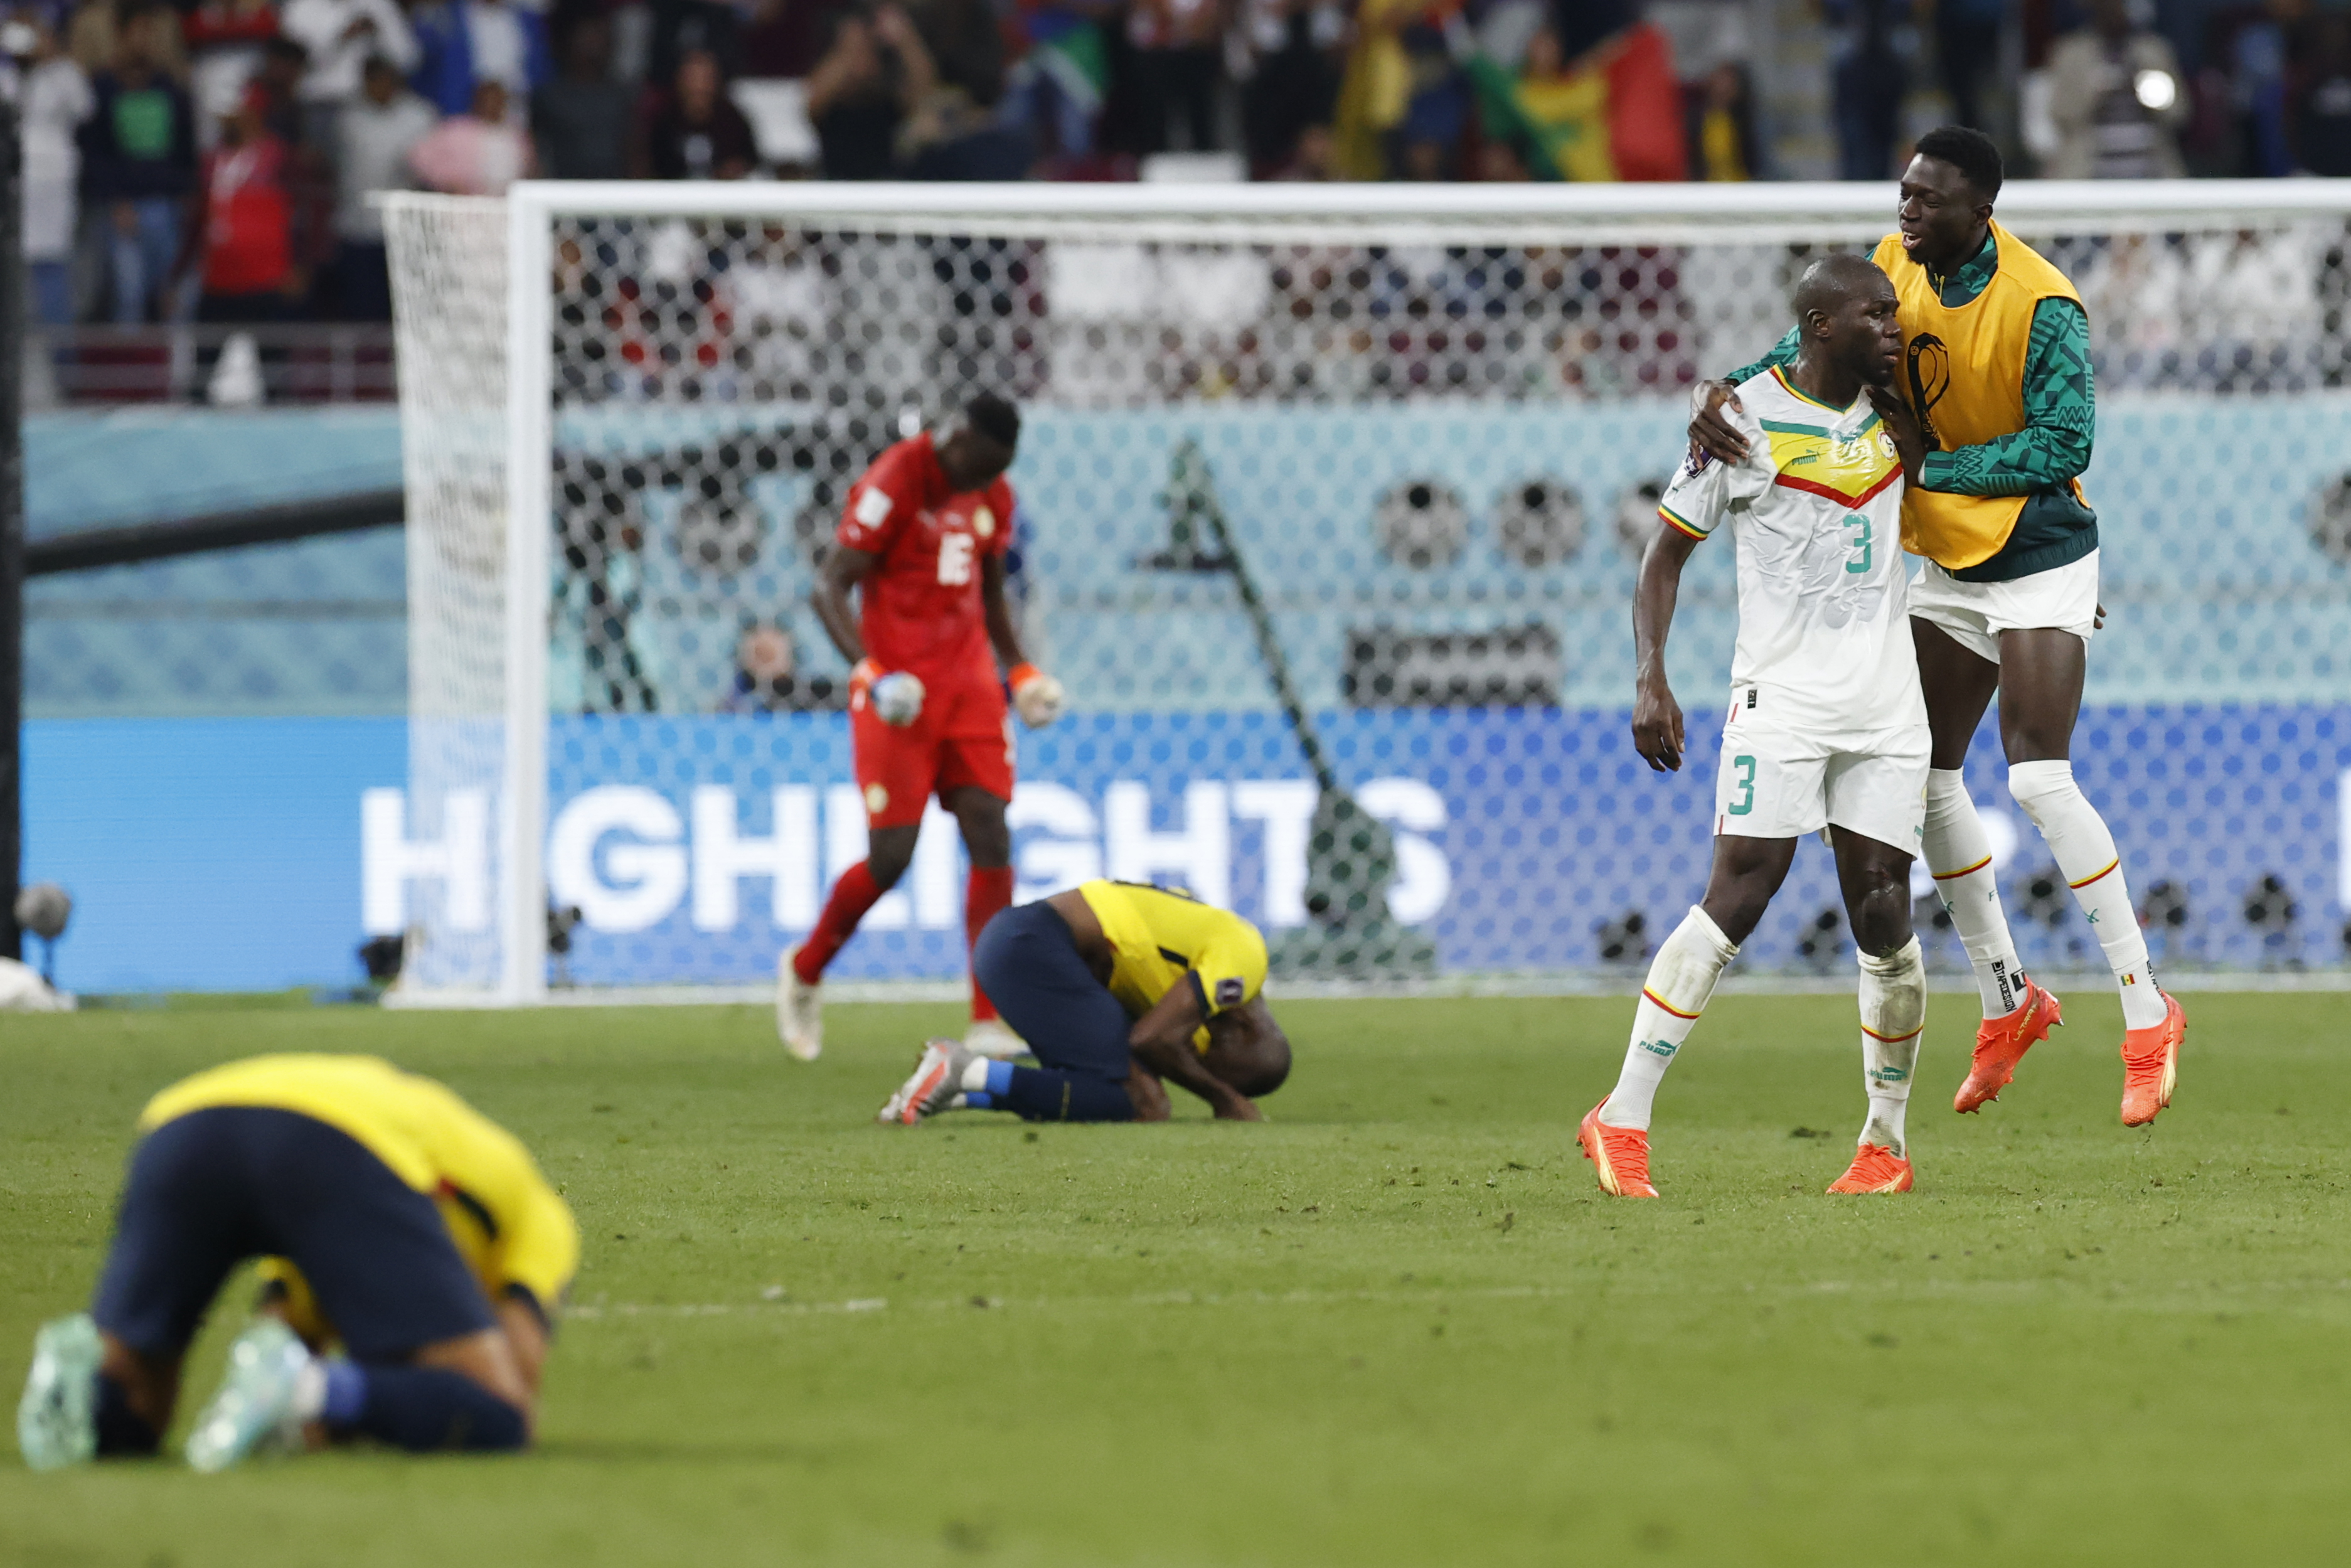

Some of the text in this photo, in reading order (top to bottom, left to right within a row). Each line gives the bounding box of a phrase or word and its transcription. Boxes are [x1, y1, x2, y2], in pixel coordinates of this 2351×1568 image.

[1843, 513, 1872, 574] 3
[1728, 755, 1756, 815] 3
[360, 776, 1452, 935] HGHLIGHTS
[1996, 970, 2017, 1013] TAPEDESIGN
